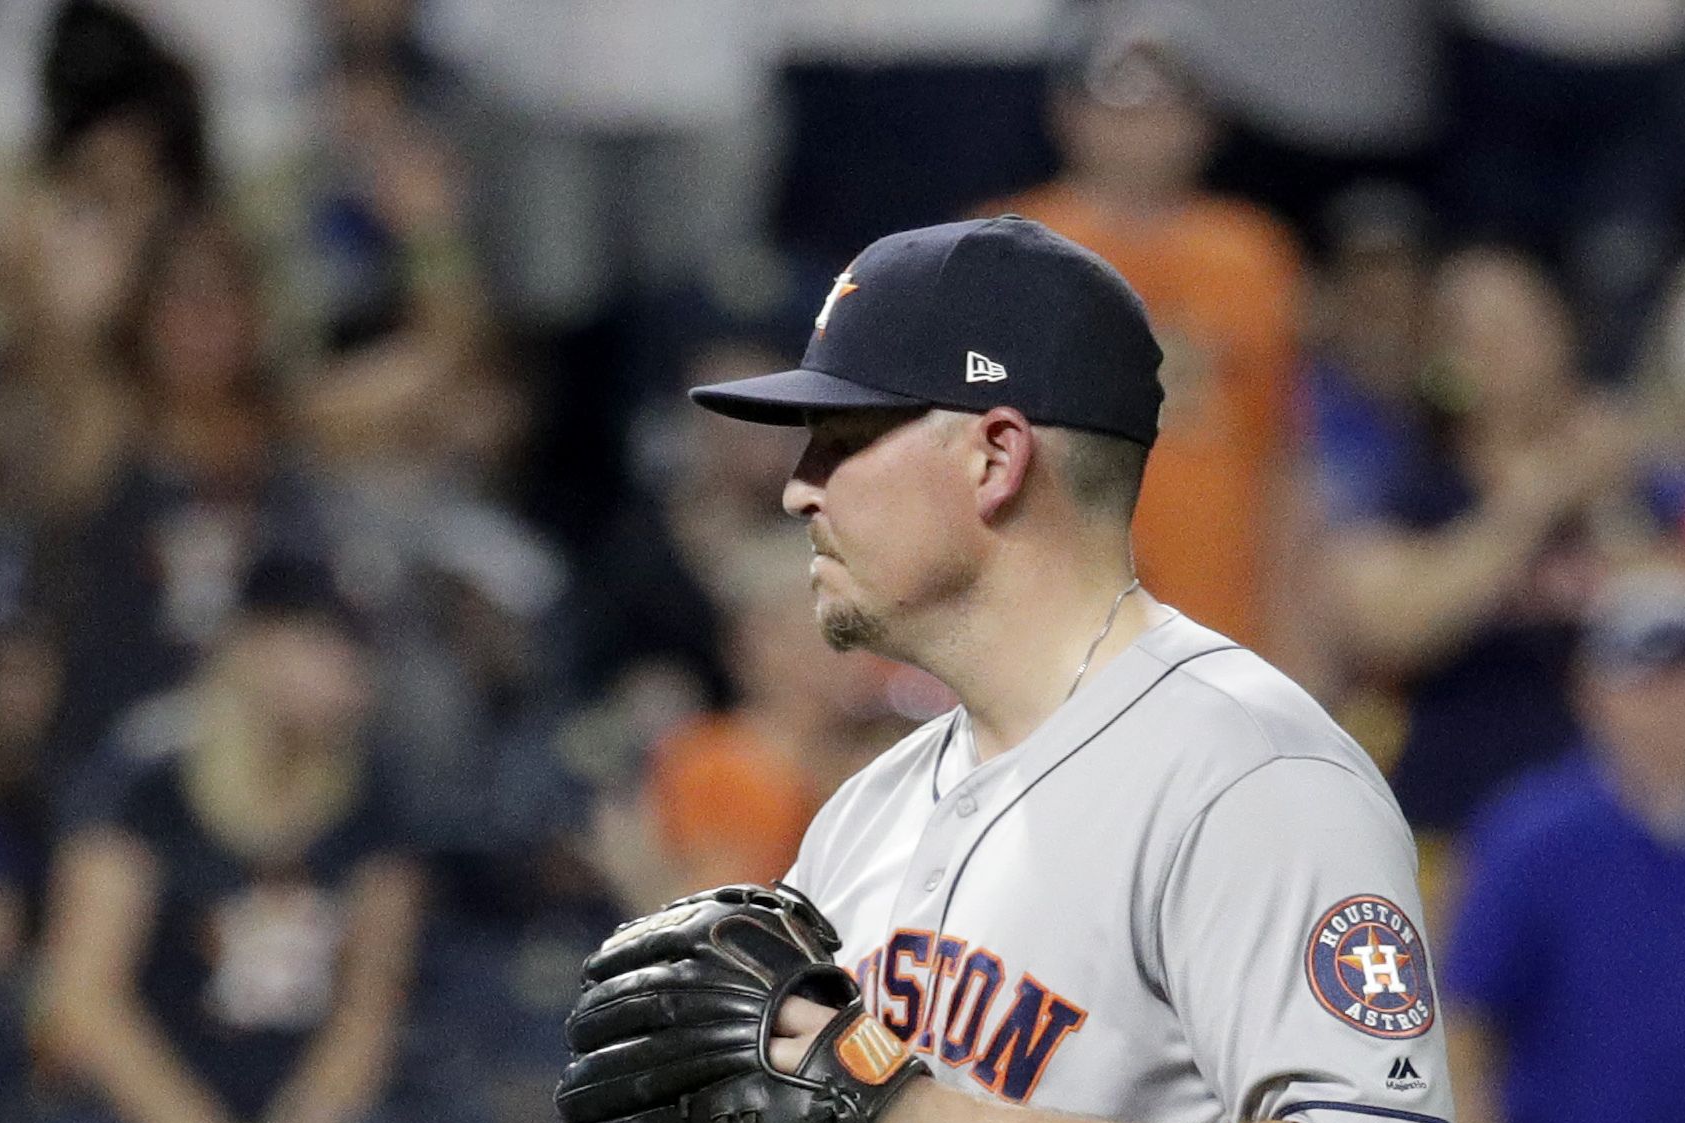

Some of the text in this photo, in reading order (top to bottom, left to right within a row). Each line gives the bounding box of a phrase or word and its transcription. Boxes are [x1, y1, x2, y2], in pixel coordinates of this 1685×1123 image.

[1319, 902, 1414, 949] HOUSTON
[1352, 944, 1407, 995] H
[1344, 1000, 1430, 1031] ASTROS
